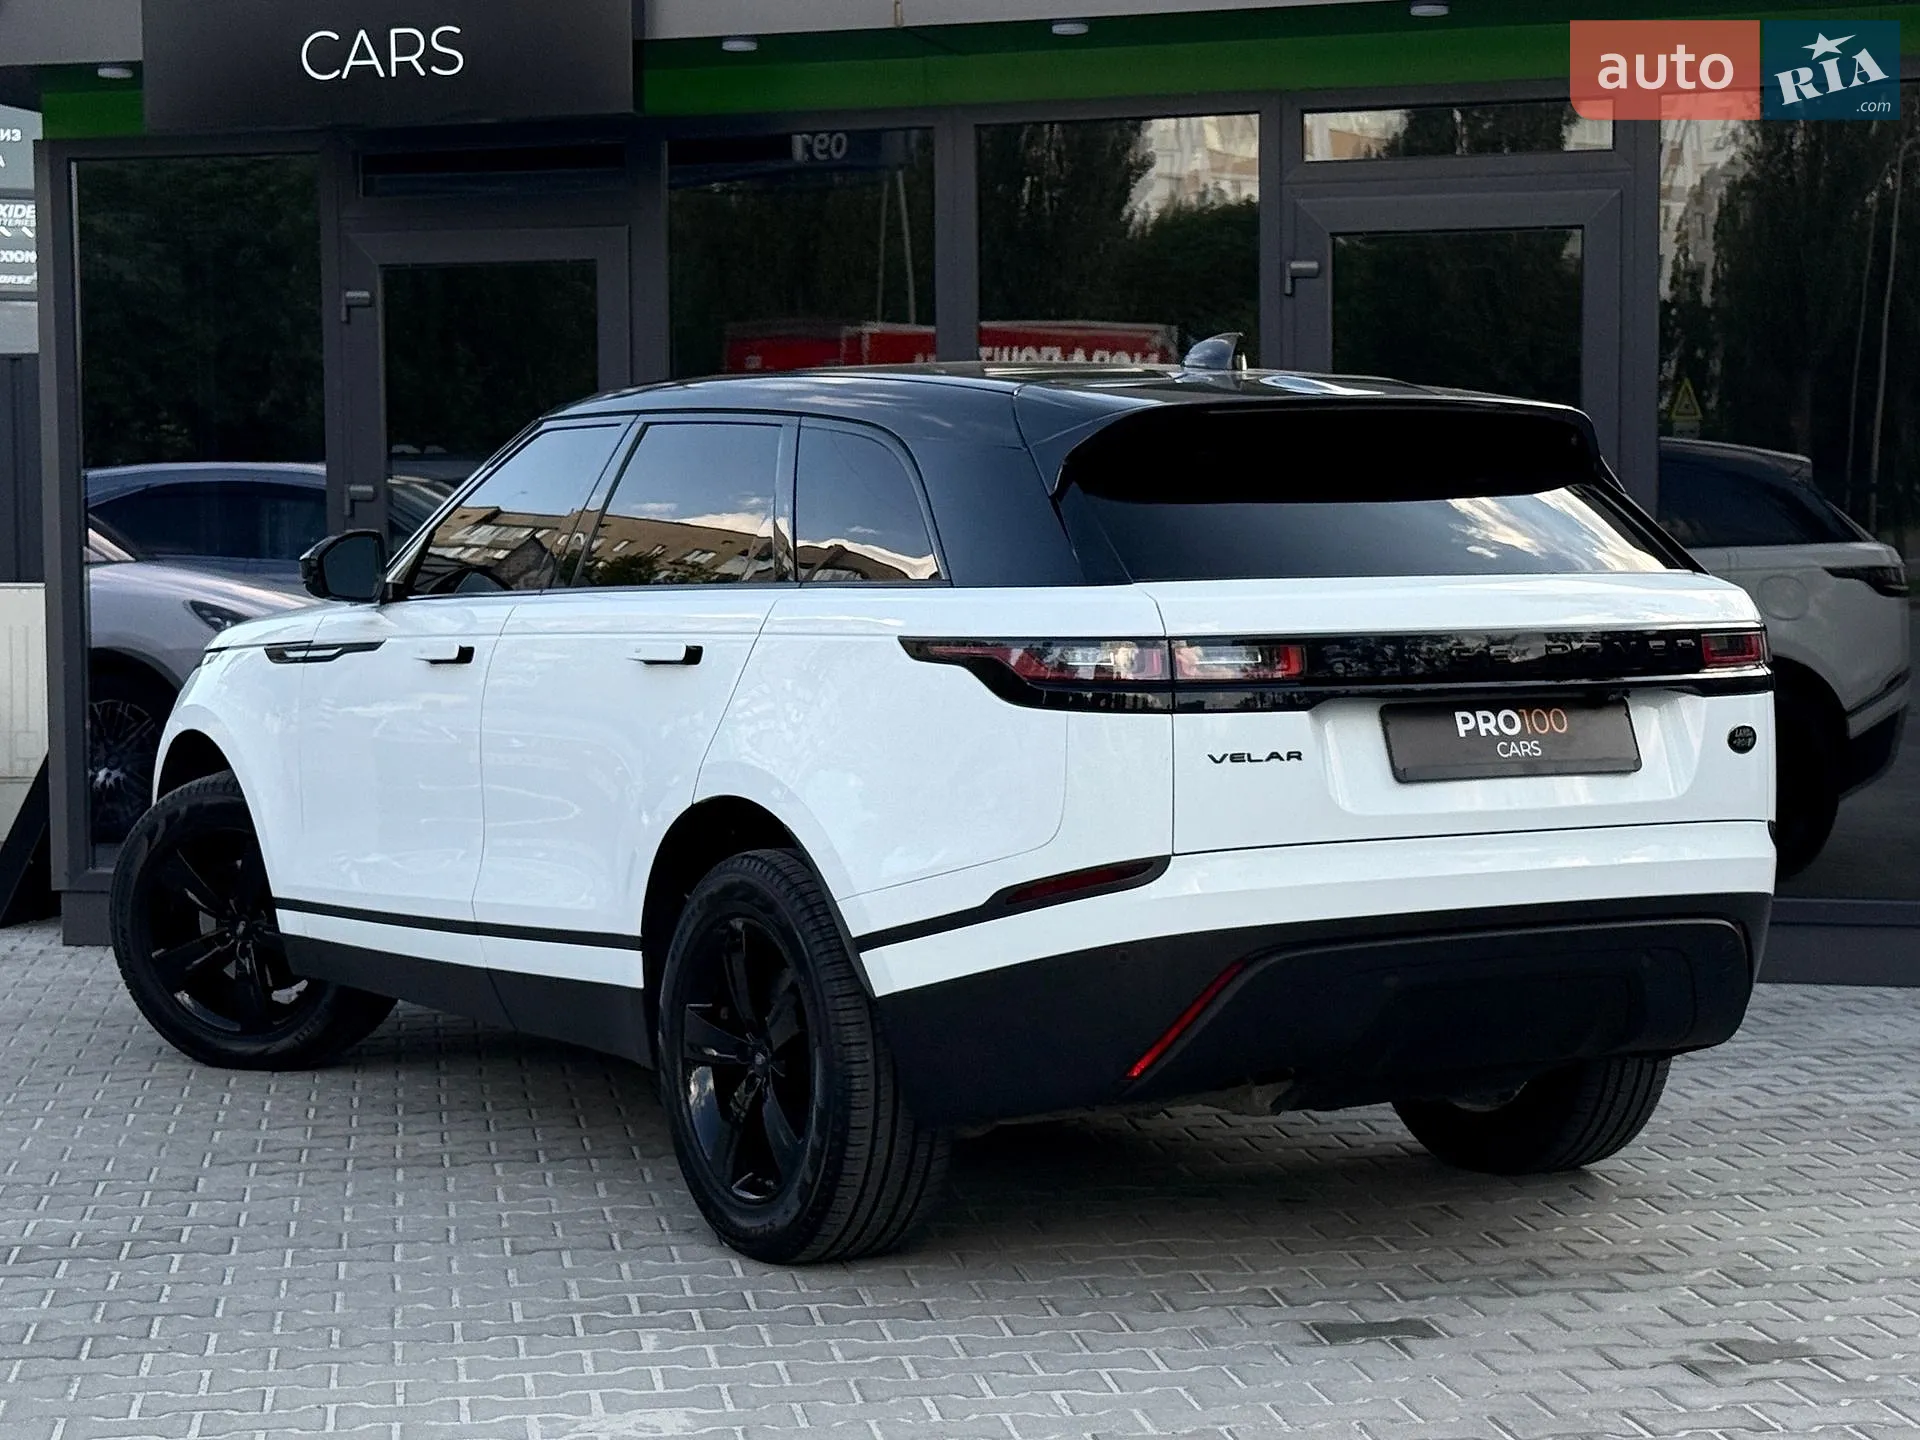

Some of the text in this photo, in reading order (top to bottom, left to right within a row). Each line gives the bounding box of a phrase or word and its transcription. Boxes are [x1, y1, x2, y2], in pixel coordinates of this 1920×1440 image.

[301, 25, 464, 81] CARS
[1453, 707, 1569, 738] PRO100
[1207, 749, 1303, 765] VELAR
[1496, 739, 1542, 759] CARS
